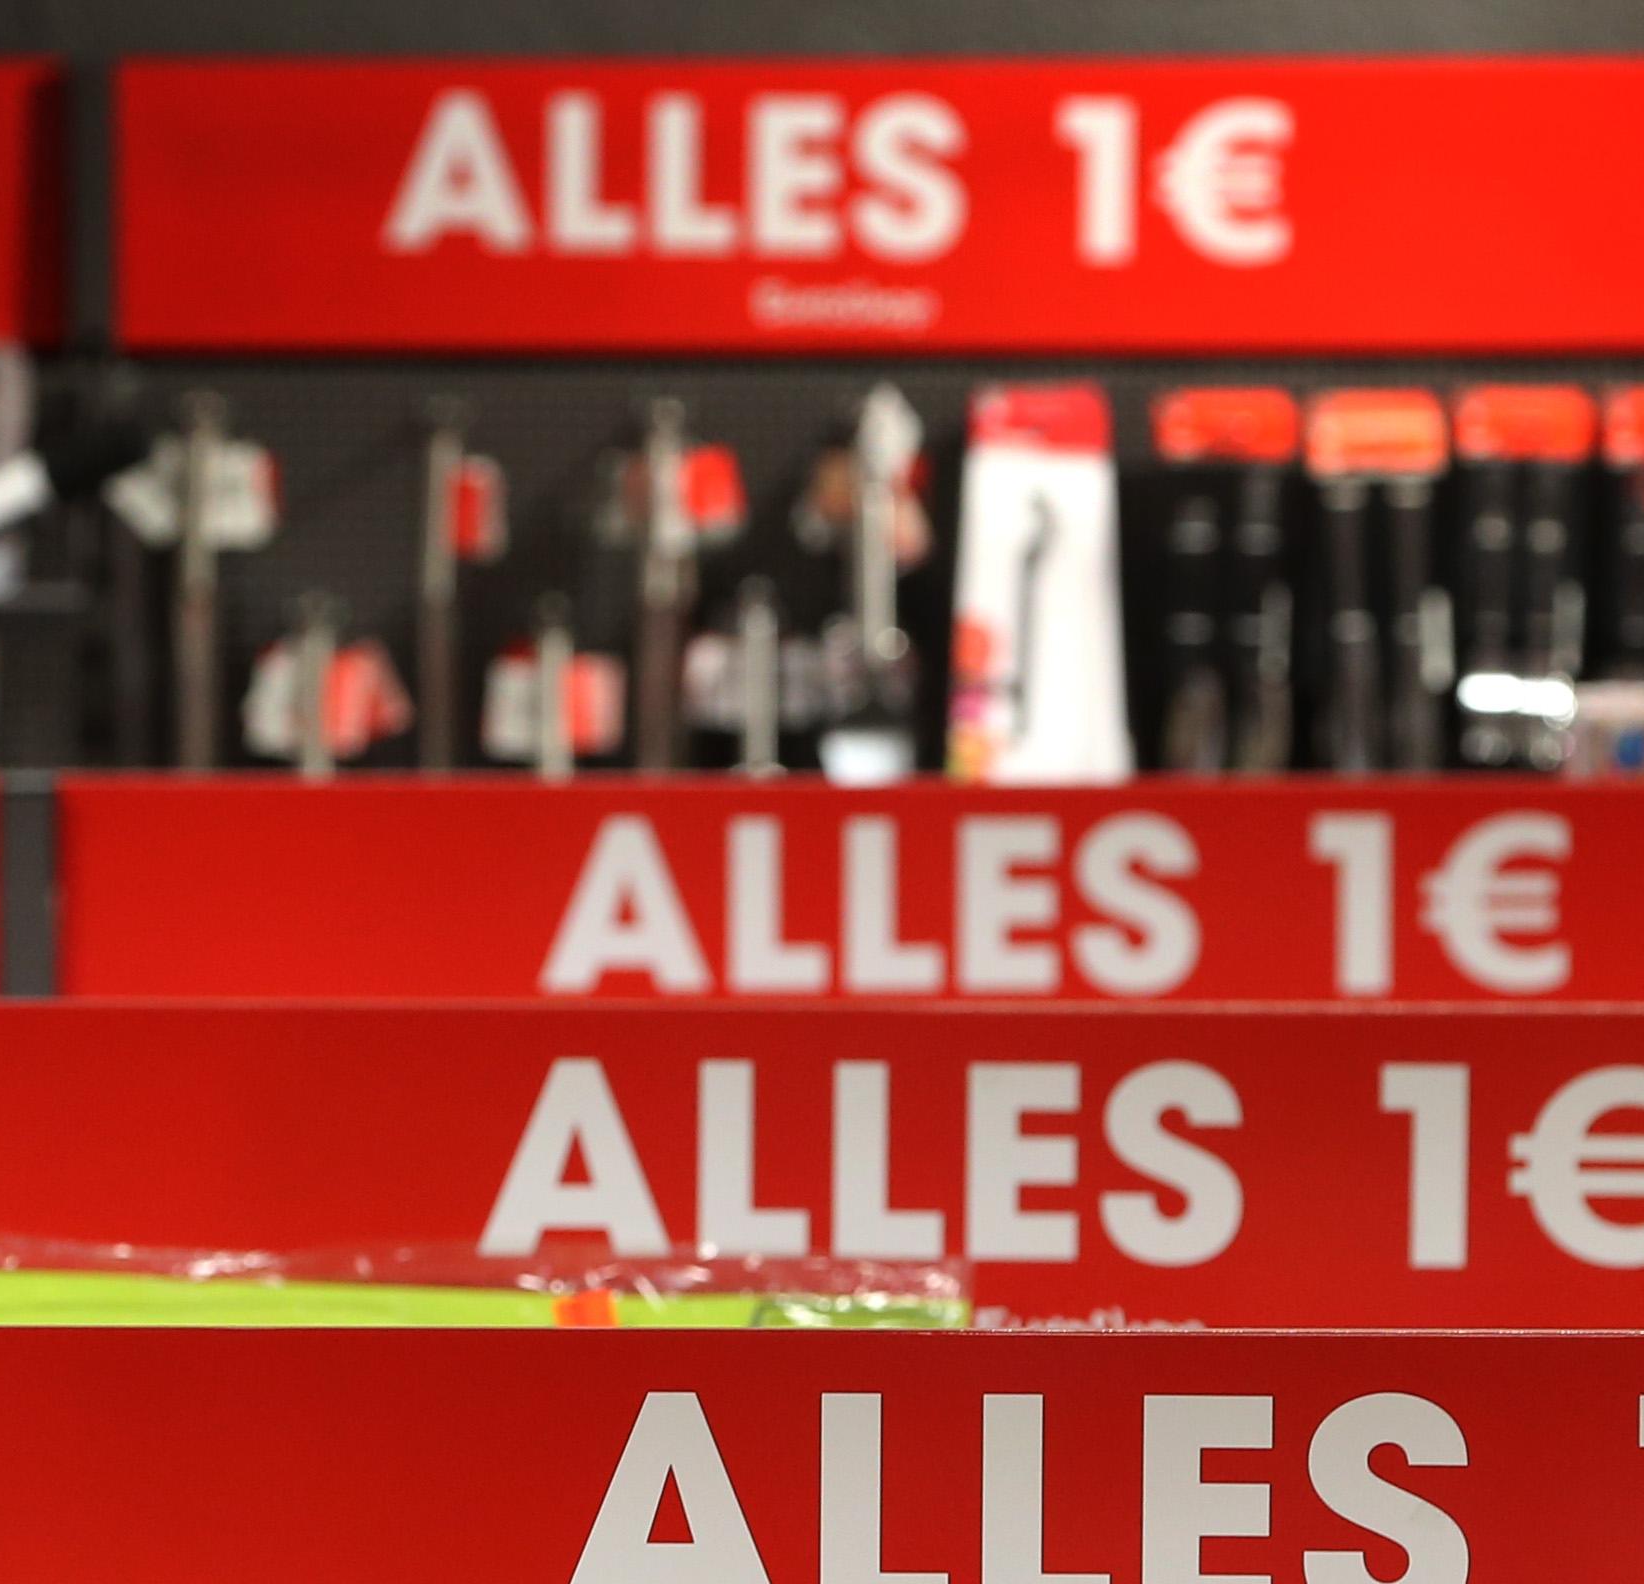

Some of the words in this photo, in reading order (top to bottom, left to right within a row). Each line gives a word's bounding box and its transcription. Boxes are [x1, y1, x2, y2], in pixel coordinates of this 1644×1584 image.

[386, 91, 968, 261] ALLES
[1056, 96, 1294, 265] 1€
[539, 814, 1201, 997] ALLES
[1309, 812, 1572, 997] 1€
[476, 1057, 1245, 1267] ALLES
